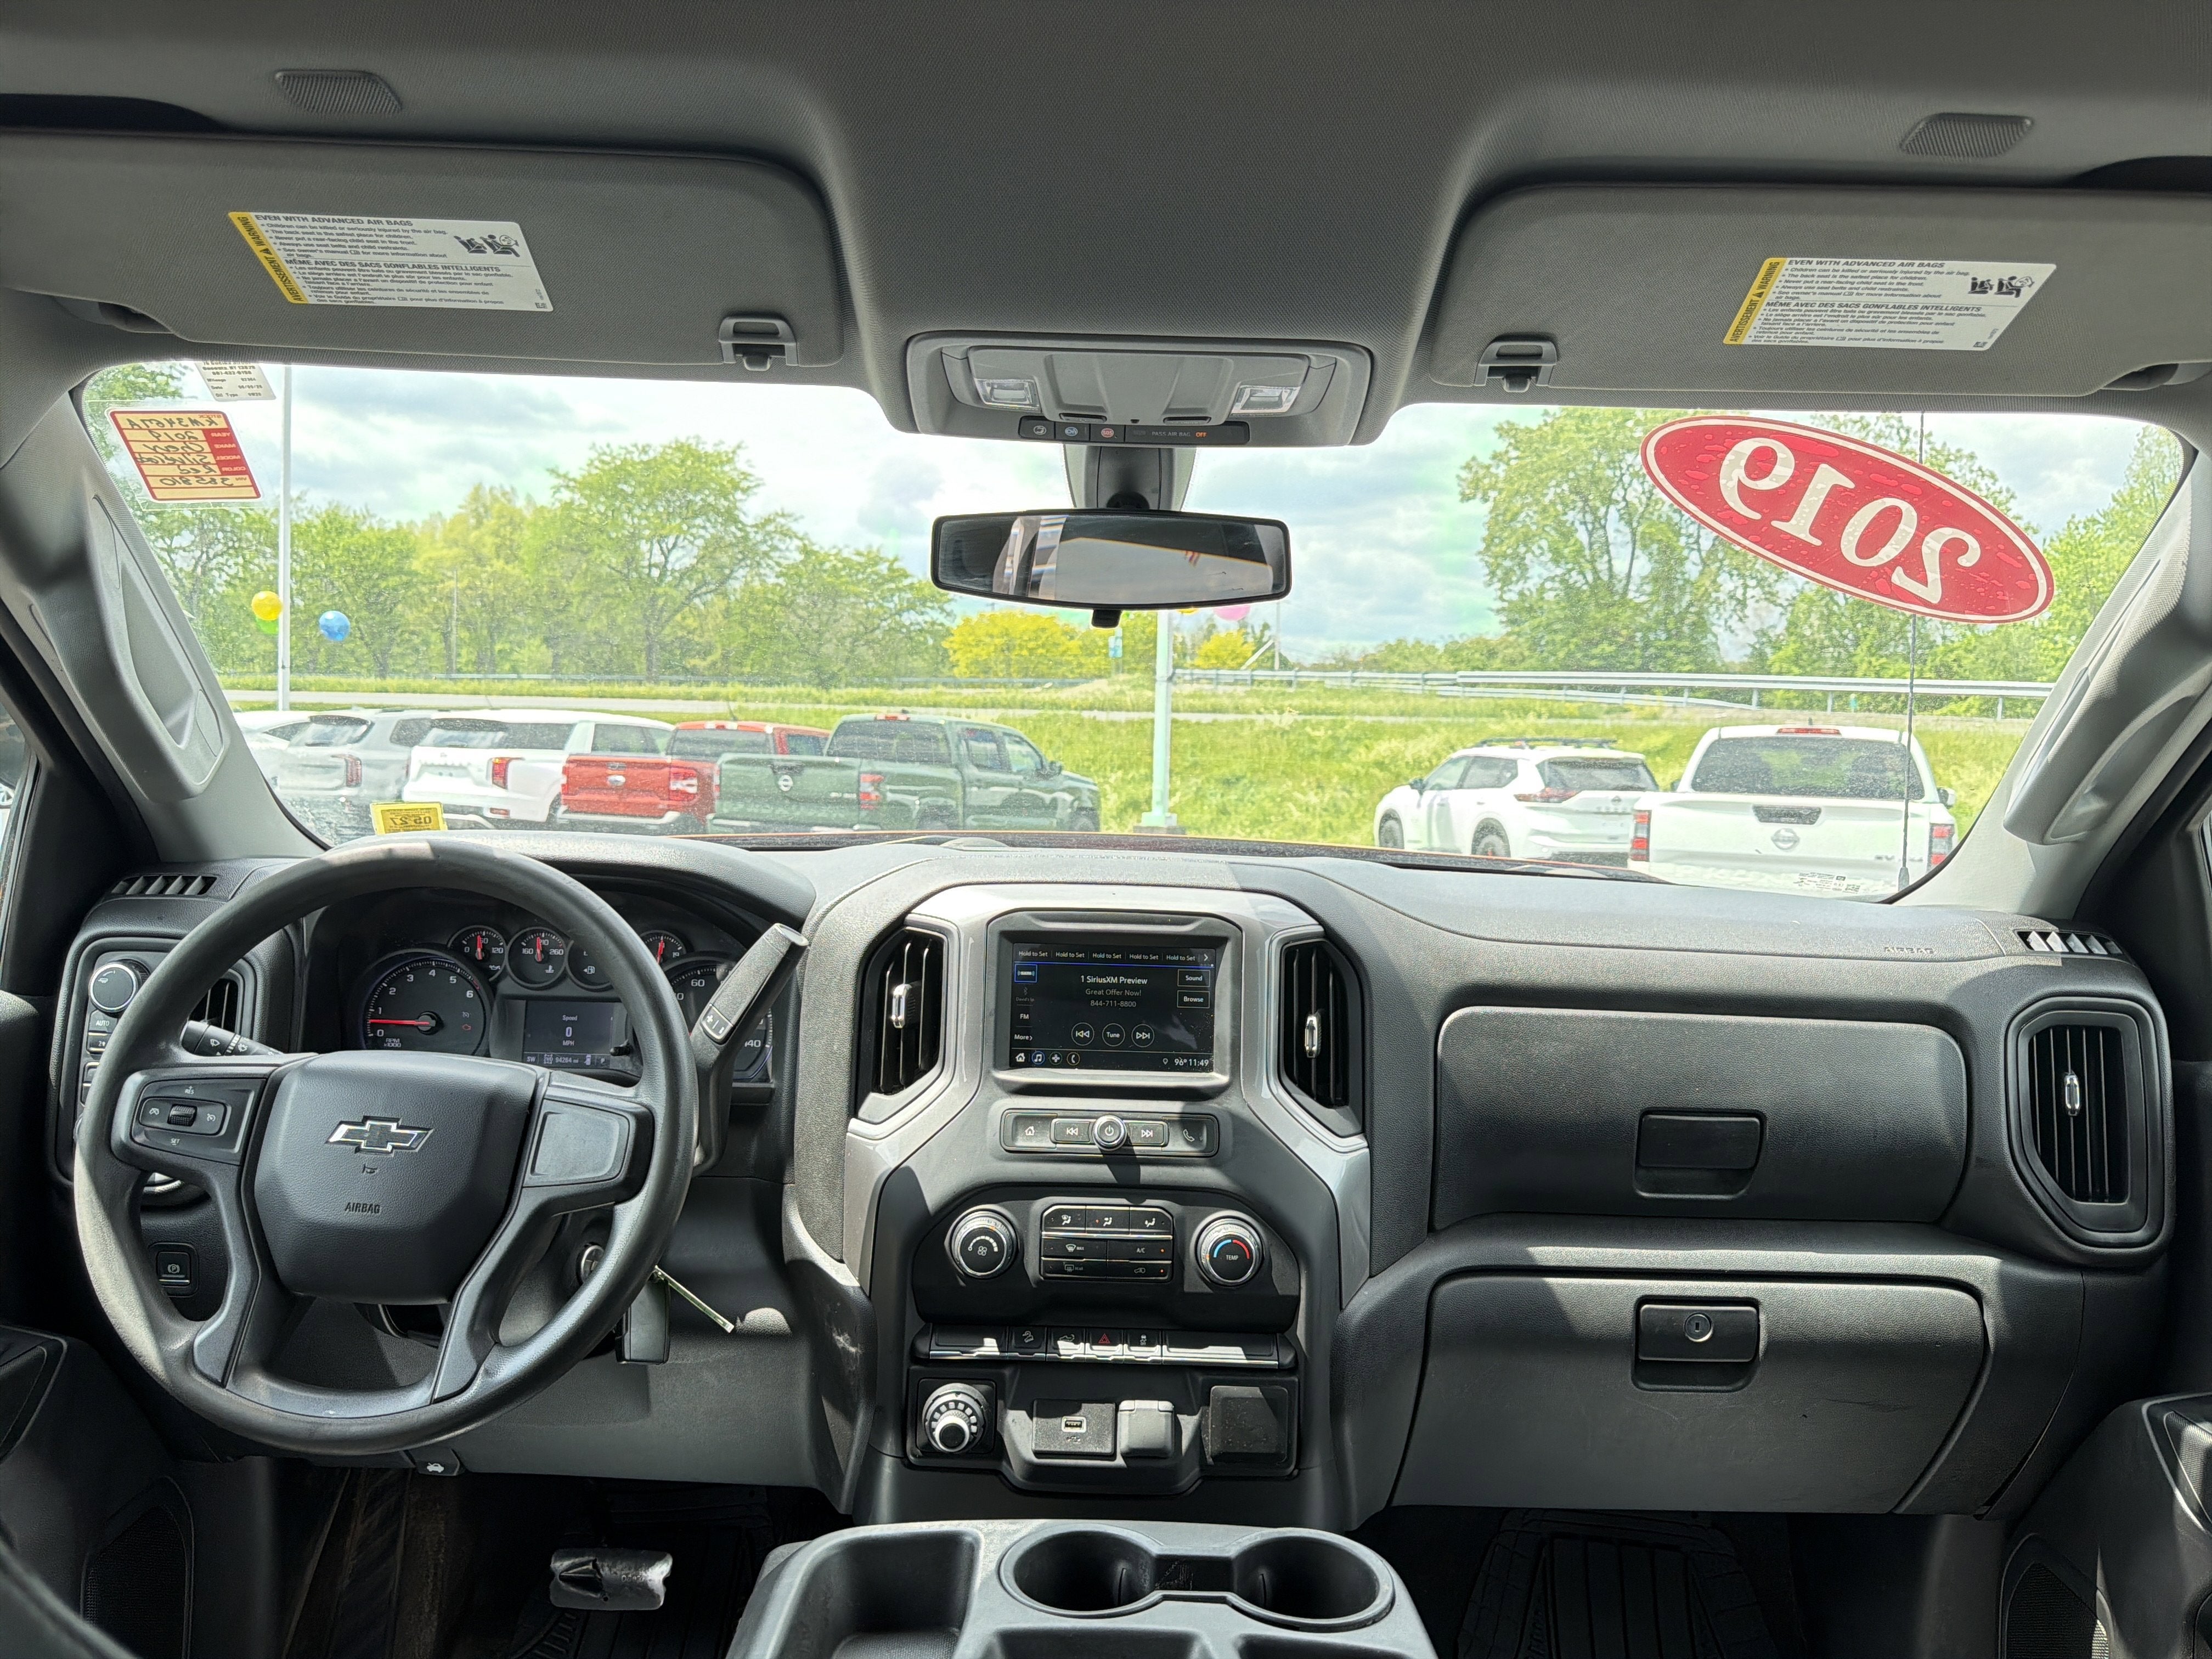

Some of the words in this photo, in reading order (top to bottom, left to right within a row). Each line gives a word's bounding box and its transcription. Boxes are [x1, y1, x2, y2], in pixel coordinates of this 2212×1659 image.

[309, 216, 365, 224] ADVANCED
[238, 217, 266, 246] WARNING
[382, 262, 441, 270] GONFLABLES
[439, 264, 501, 272] INTELLIGENTS
[264, 256, 304, 302] AVERTISSEMENT
[1730, 300, 1759, 342] AVERTISSEMENT
[1756, 262, 1780, 290] WARNING
[675, 992, 684, 1001] 0
[566, 1027, 572, 1037] 0
[345, 1202, 380, 1214] AIRBAG
